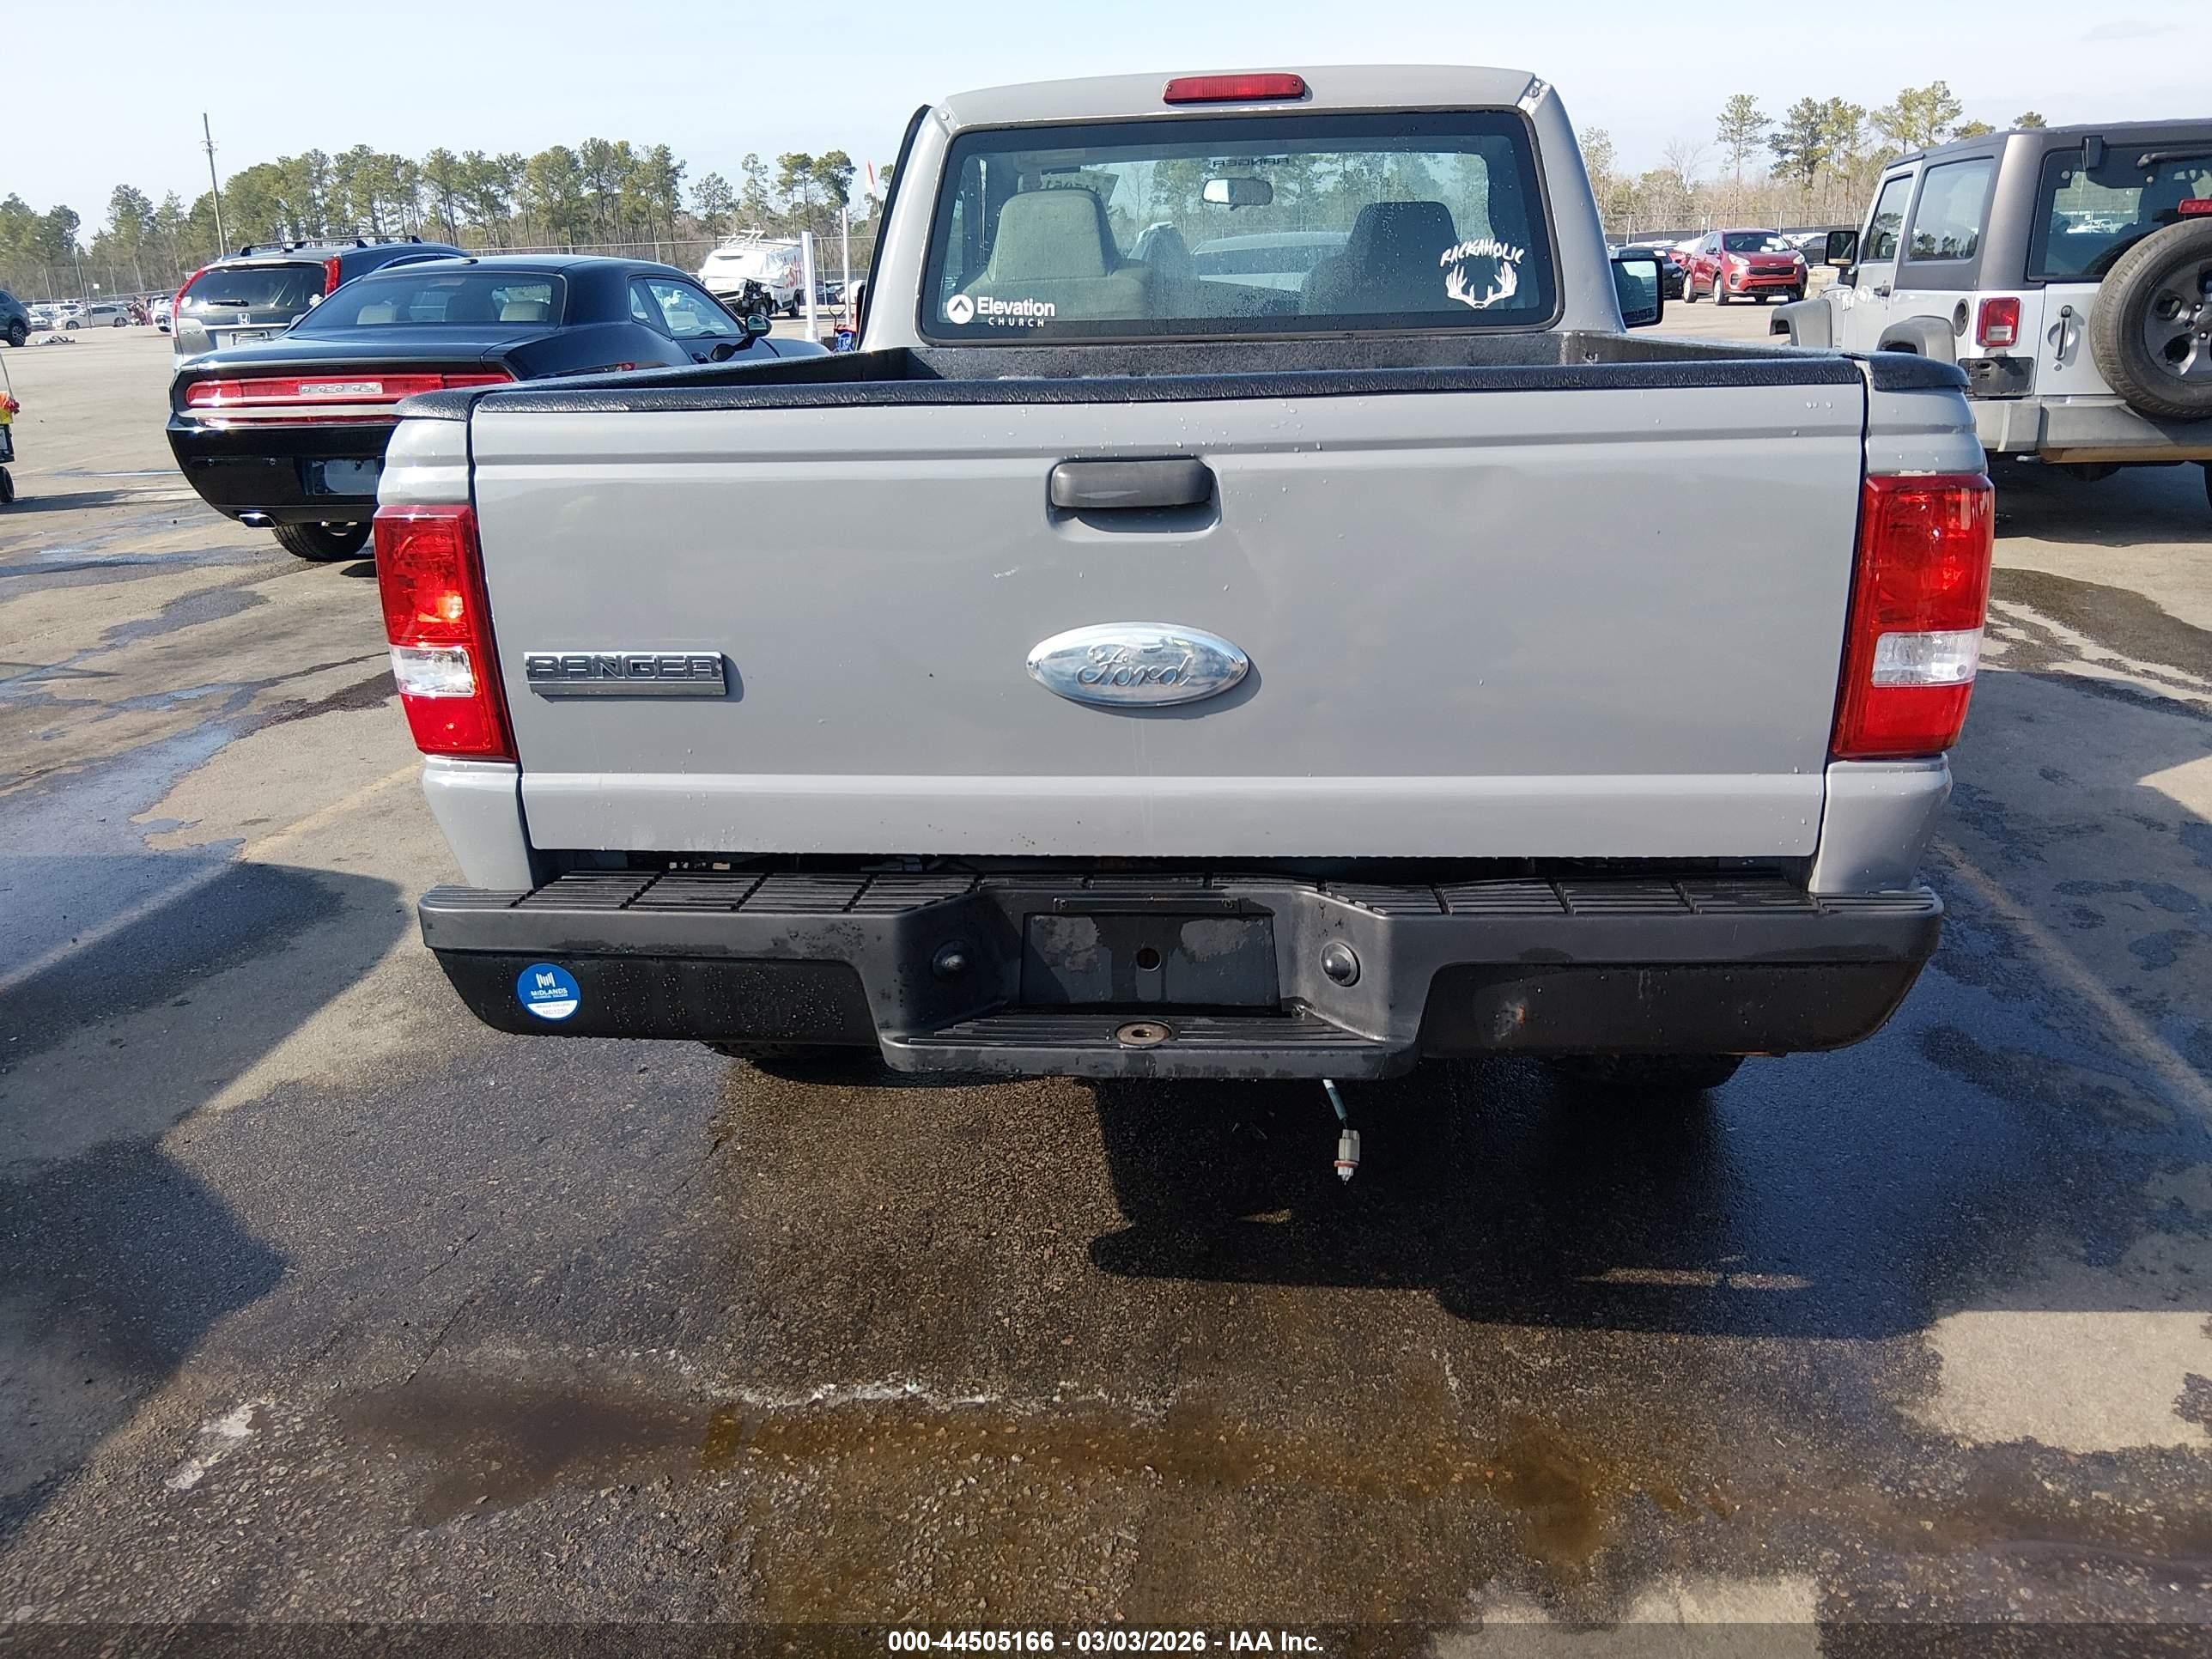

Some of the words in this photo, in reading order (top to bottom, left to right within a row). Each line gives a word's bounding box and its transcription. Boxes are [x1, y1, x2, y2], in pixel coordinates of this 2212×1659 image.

[1439, 238, 1526, 268] RACKAHOLIC
[976, 296, 1055, 317] Elevation
[988, 316, 1044, 327] CHURCH
[526, 654, 723, 679] RANGER
[1076, 636, 1194, 688] Ford
[530, 988, 568, 997] MIDLANDS
